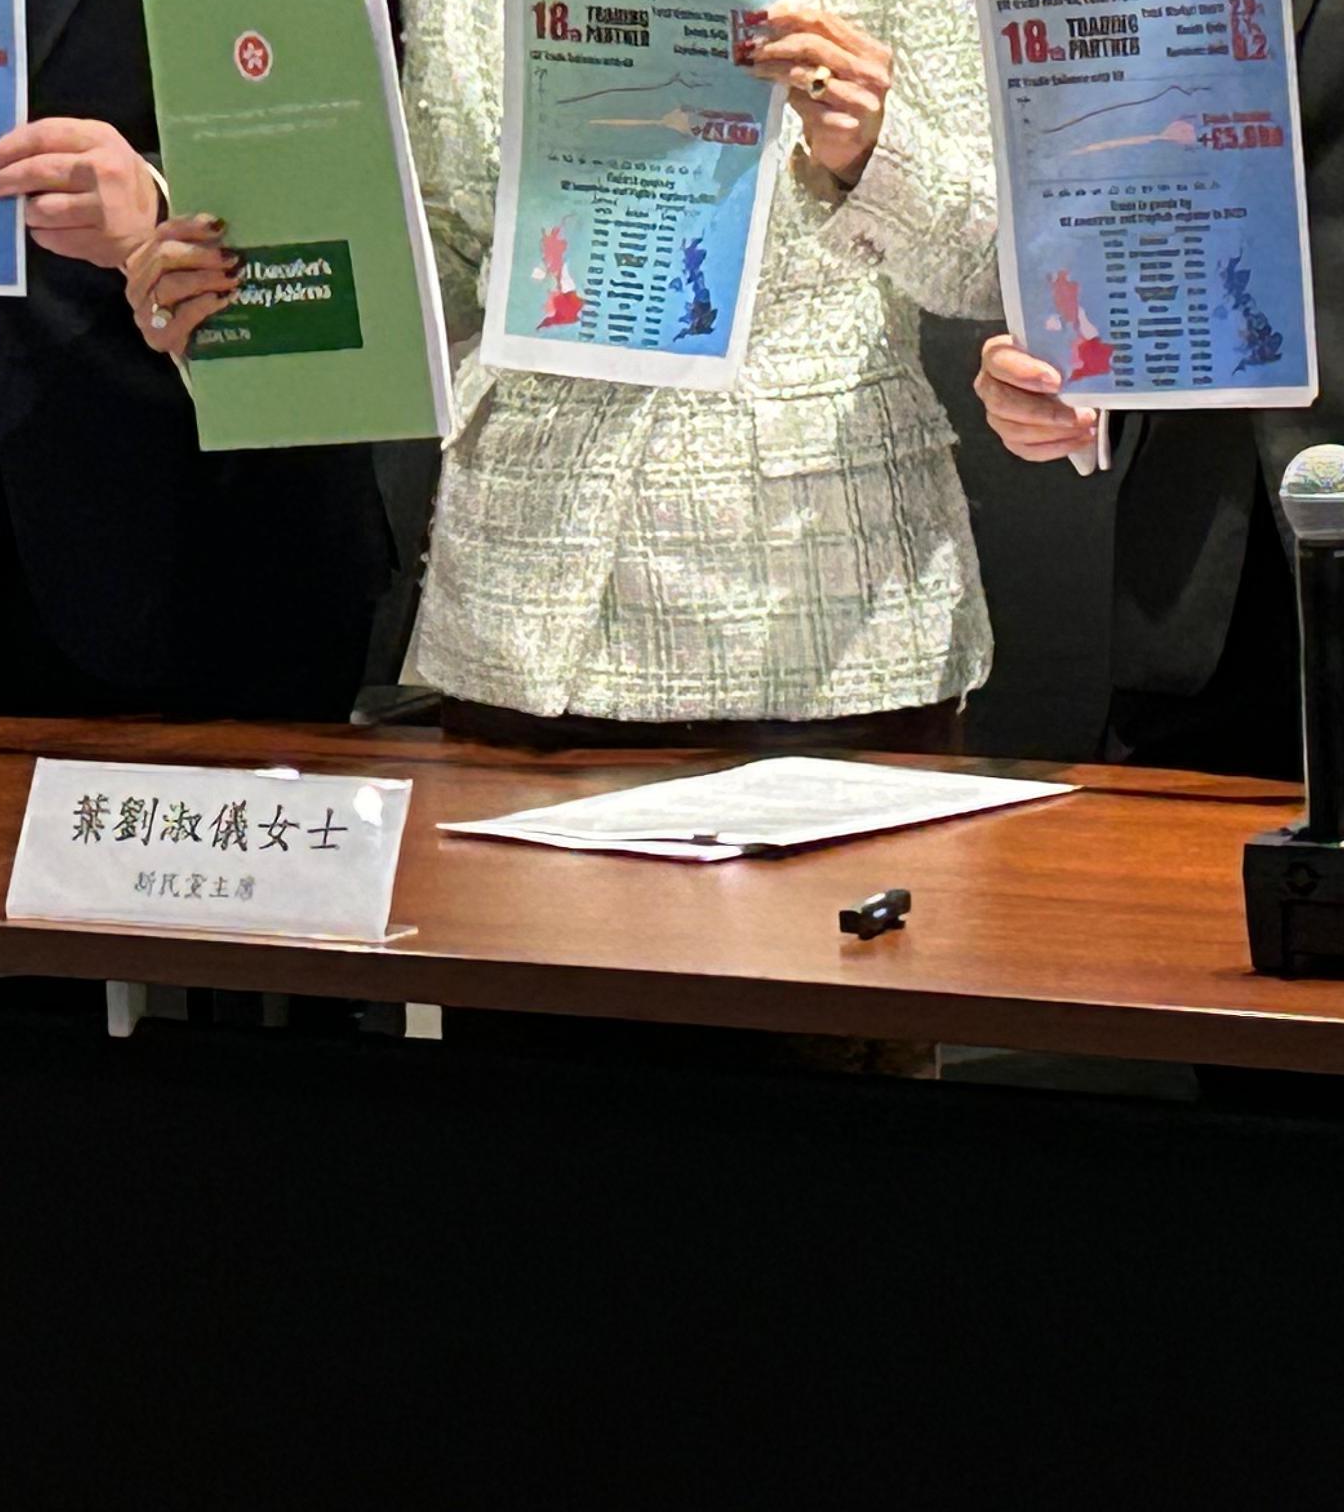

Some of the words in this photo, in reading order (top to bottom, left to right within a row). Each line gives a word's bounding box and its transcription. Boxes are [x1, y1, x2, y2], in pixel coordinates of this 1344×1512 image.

[1065, 14, 1139, 37] TRADING
[1067, 37, 1140, 61] PARTNER
[71, 793, 350, 851] 葉劉淑儀女士
